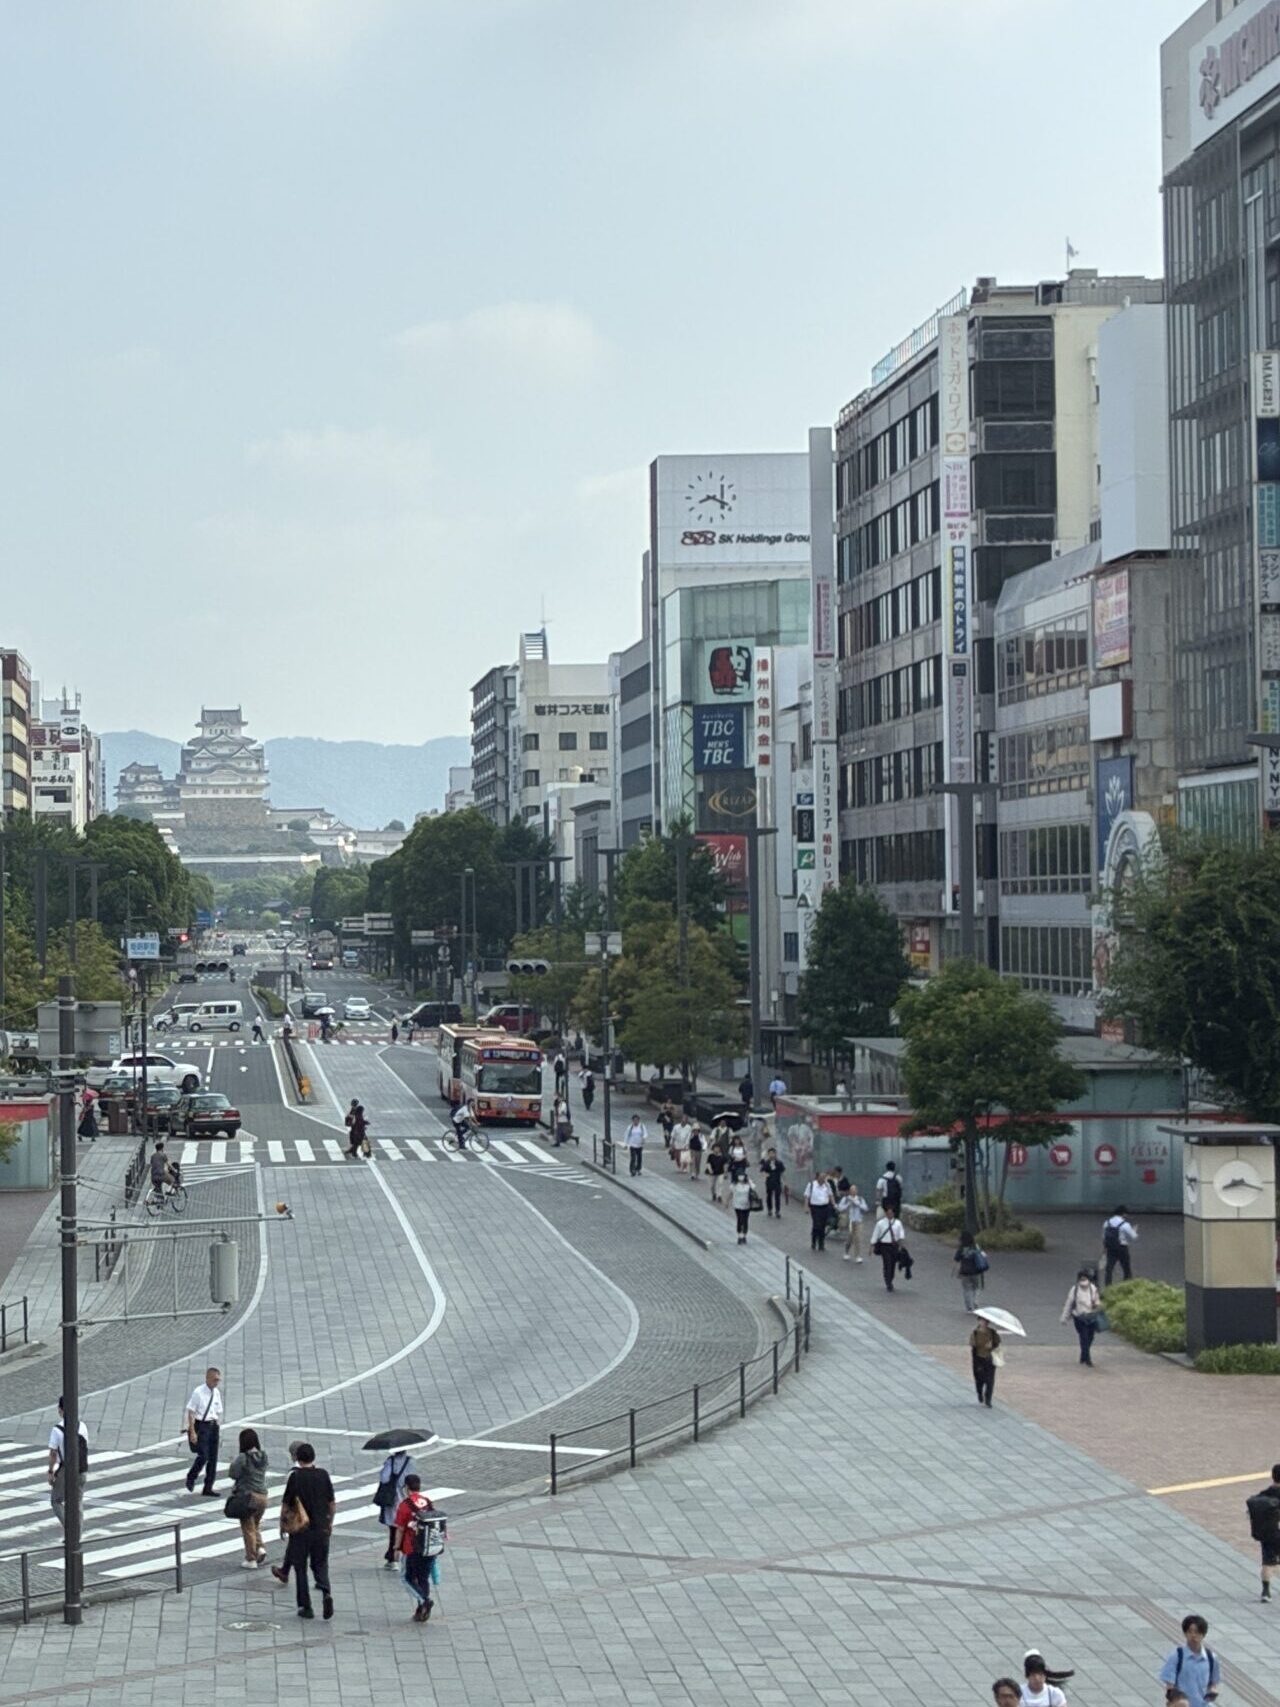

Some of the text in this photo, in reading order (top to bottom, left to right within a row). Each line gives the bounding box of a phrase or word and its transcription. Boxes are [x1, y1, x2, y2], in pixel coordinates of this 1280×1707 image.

[719, 533, 810, 545] SK Holdings Grou
[757, 659, 770, 765] 播州信用金庫
[702, 720, 734, 736] TBC
[703, 748, 734, 765] TBC
